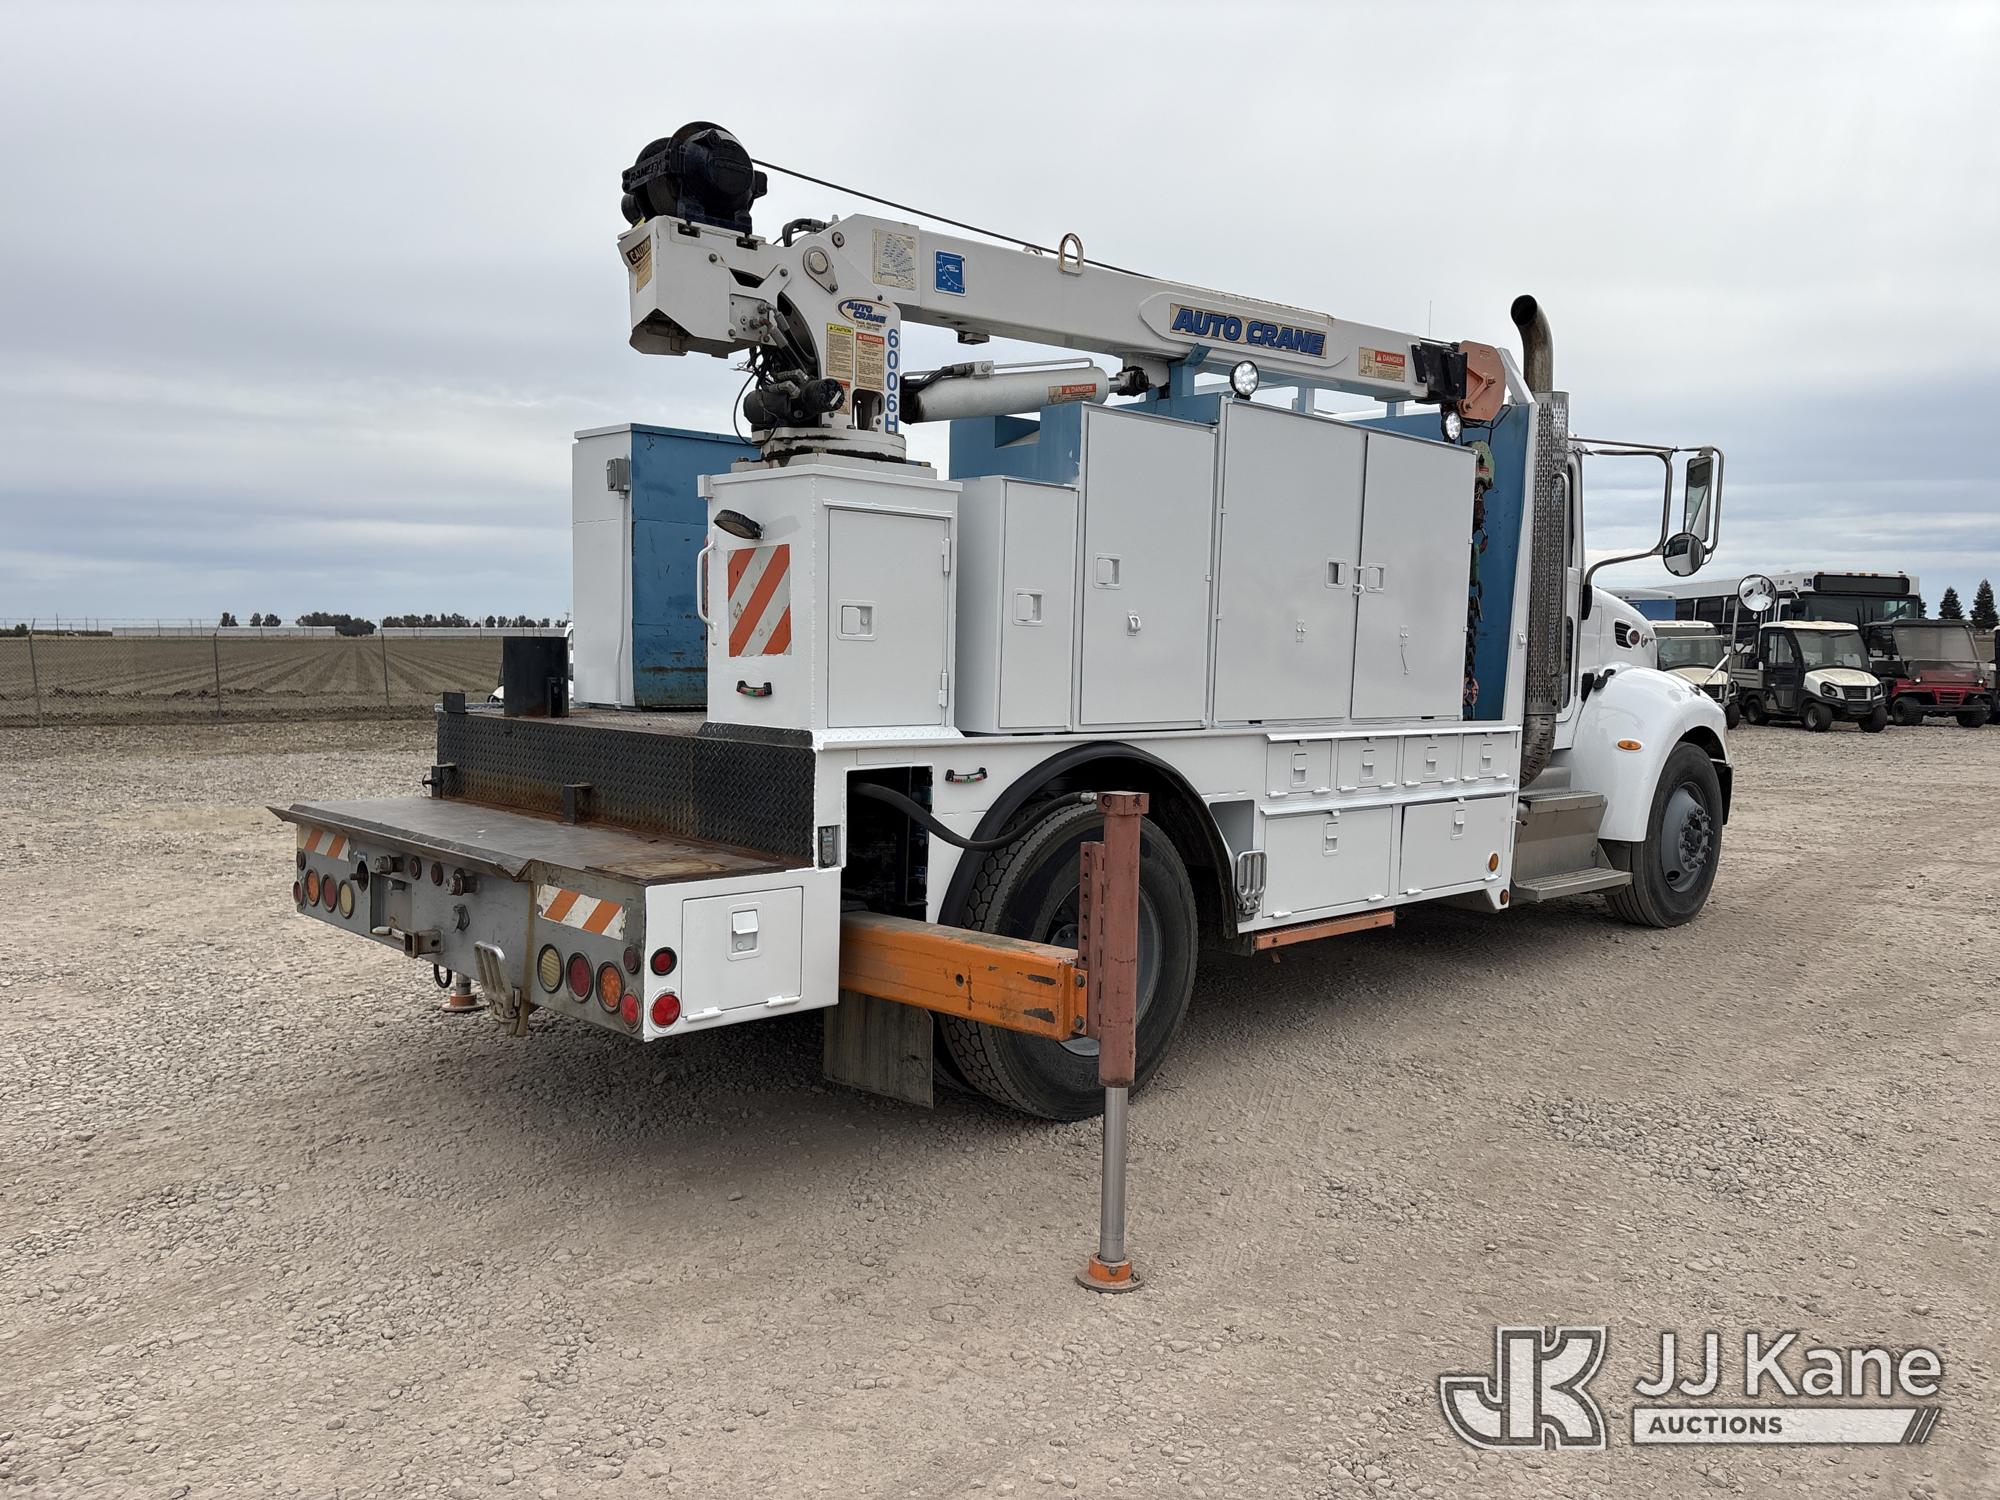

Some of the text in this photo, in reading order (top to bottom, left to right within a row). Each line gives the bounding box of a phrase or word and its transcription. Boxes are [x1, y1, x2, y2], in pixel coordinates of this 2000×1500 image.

[846, 302, 872, 313] AUTO
[853, 311, 886, 324] CRANE
[833, 325, 852, 334] CAUTION
[1172, 307, 1326, 356] AUTO CRANE
[862, 334, 883, 344] DANGER
[1382, 354, 1404, 365] DANGER
[885, 328, 899, 434] 6006H
[1071, 385, 1093, 394] DANGER
